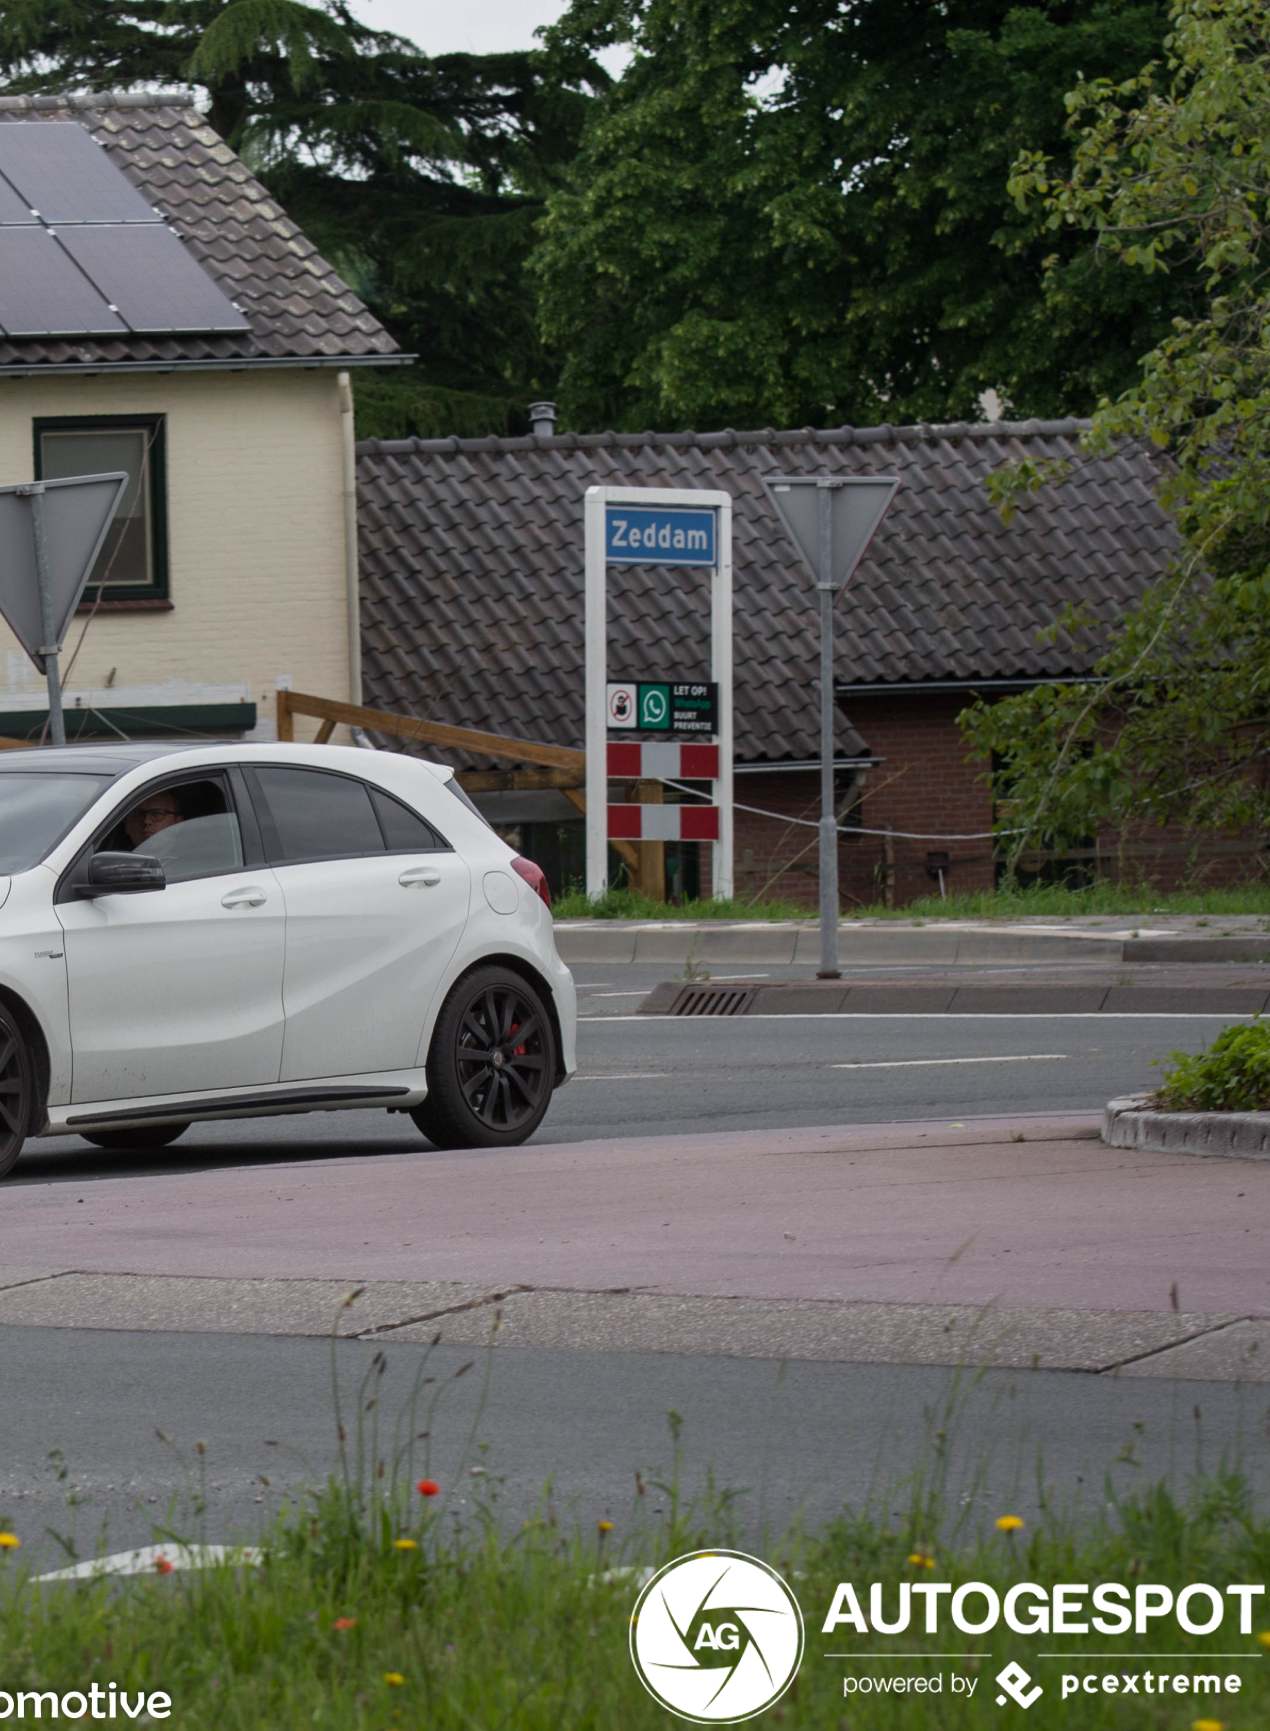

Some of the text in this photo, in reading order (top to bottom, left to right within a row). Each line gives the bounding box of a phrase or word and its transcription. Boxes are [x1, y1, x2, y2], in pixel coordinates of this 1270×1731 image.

[611, 520, 708, 550] Zeddam
[673, 685, 707, 697] LET OP!
[673, 711, 697, 720] BUURT
[673, 721, 712, 731] PREVENTIE
